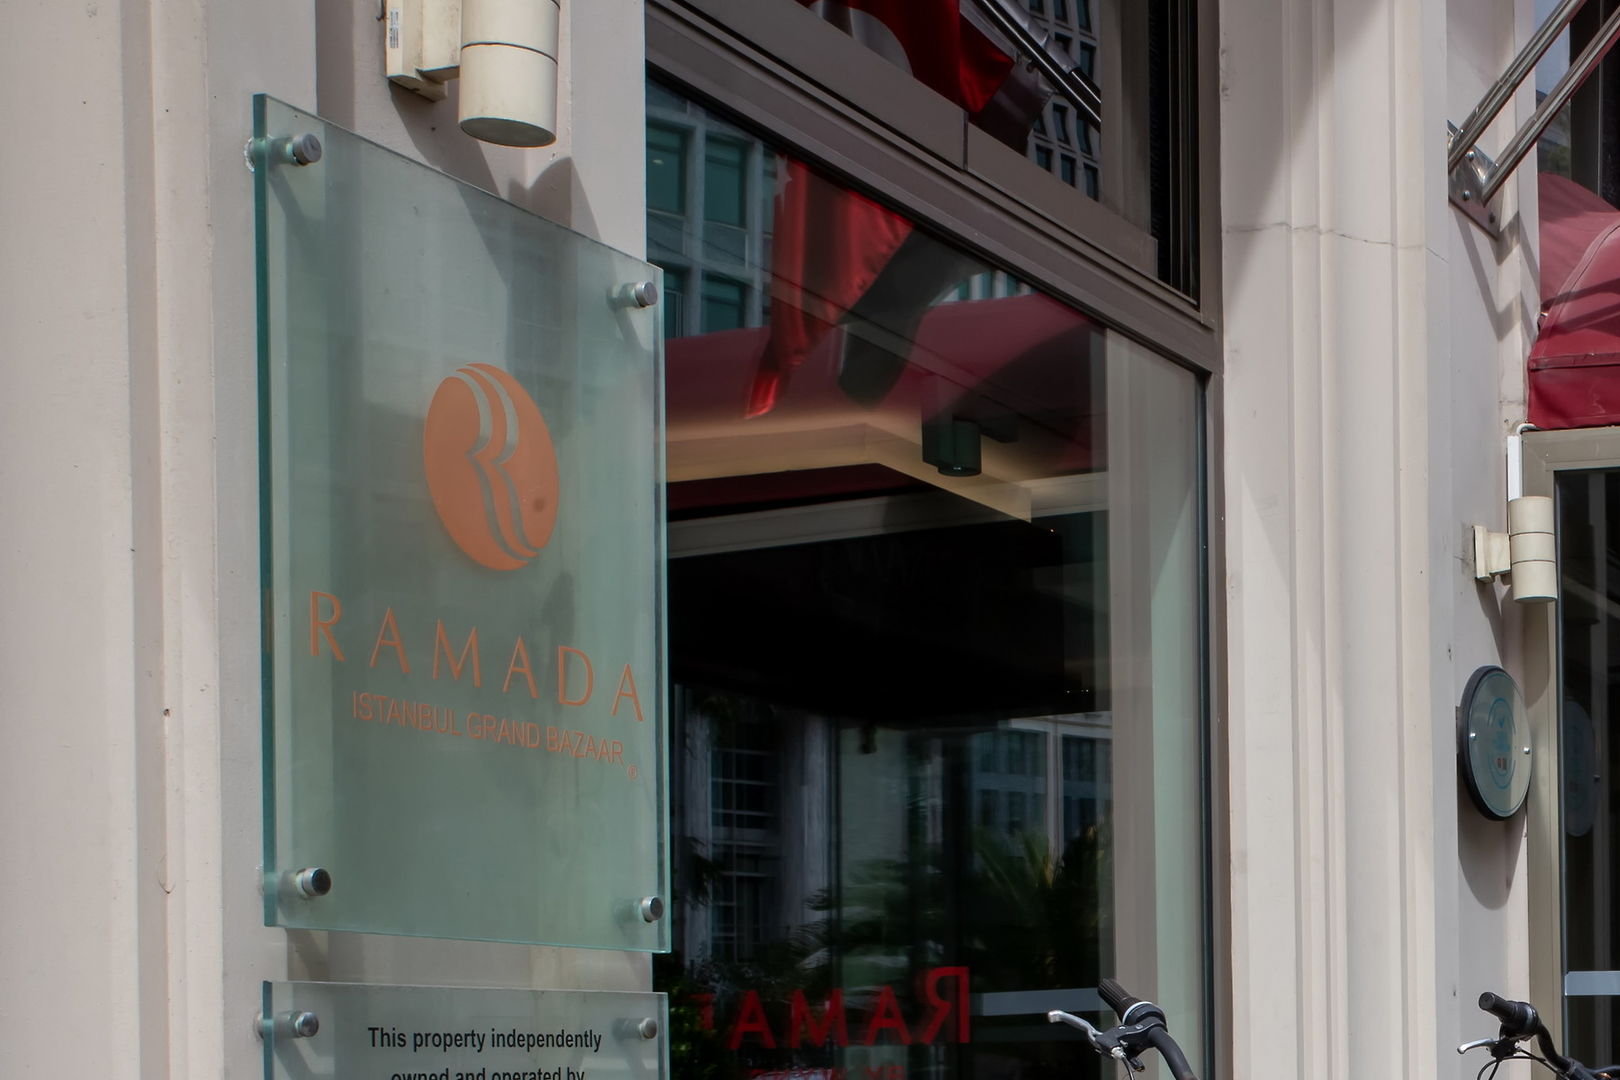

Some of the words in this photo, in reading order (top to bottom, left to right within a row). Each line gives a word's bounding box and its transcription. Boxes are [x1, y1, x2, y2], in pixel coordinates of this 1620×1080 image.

[310, 590, 644, 722] RAMADA
[352, 690, 463, 736] ISTANBUL
[466, 712, 541, 749] GRAND
[545, 726, 624, 765] BAZAAR
[367, 1027, 407, 1048] This
[413, 1029, 486, 1052] property
[491, 1028, 602, 1053] independently
